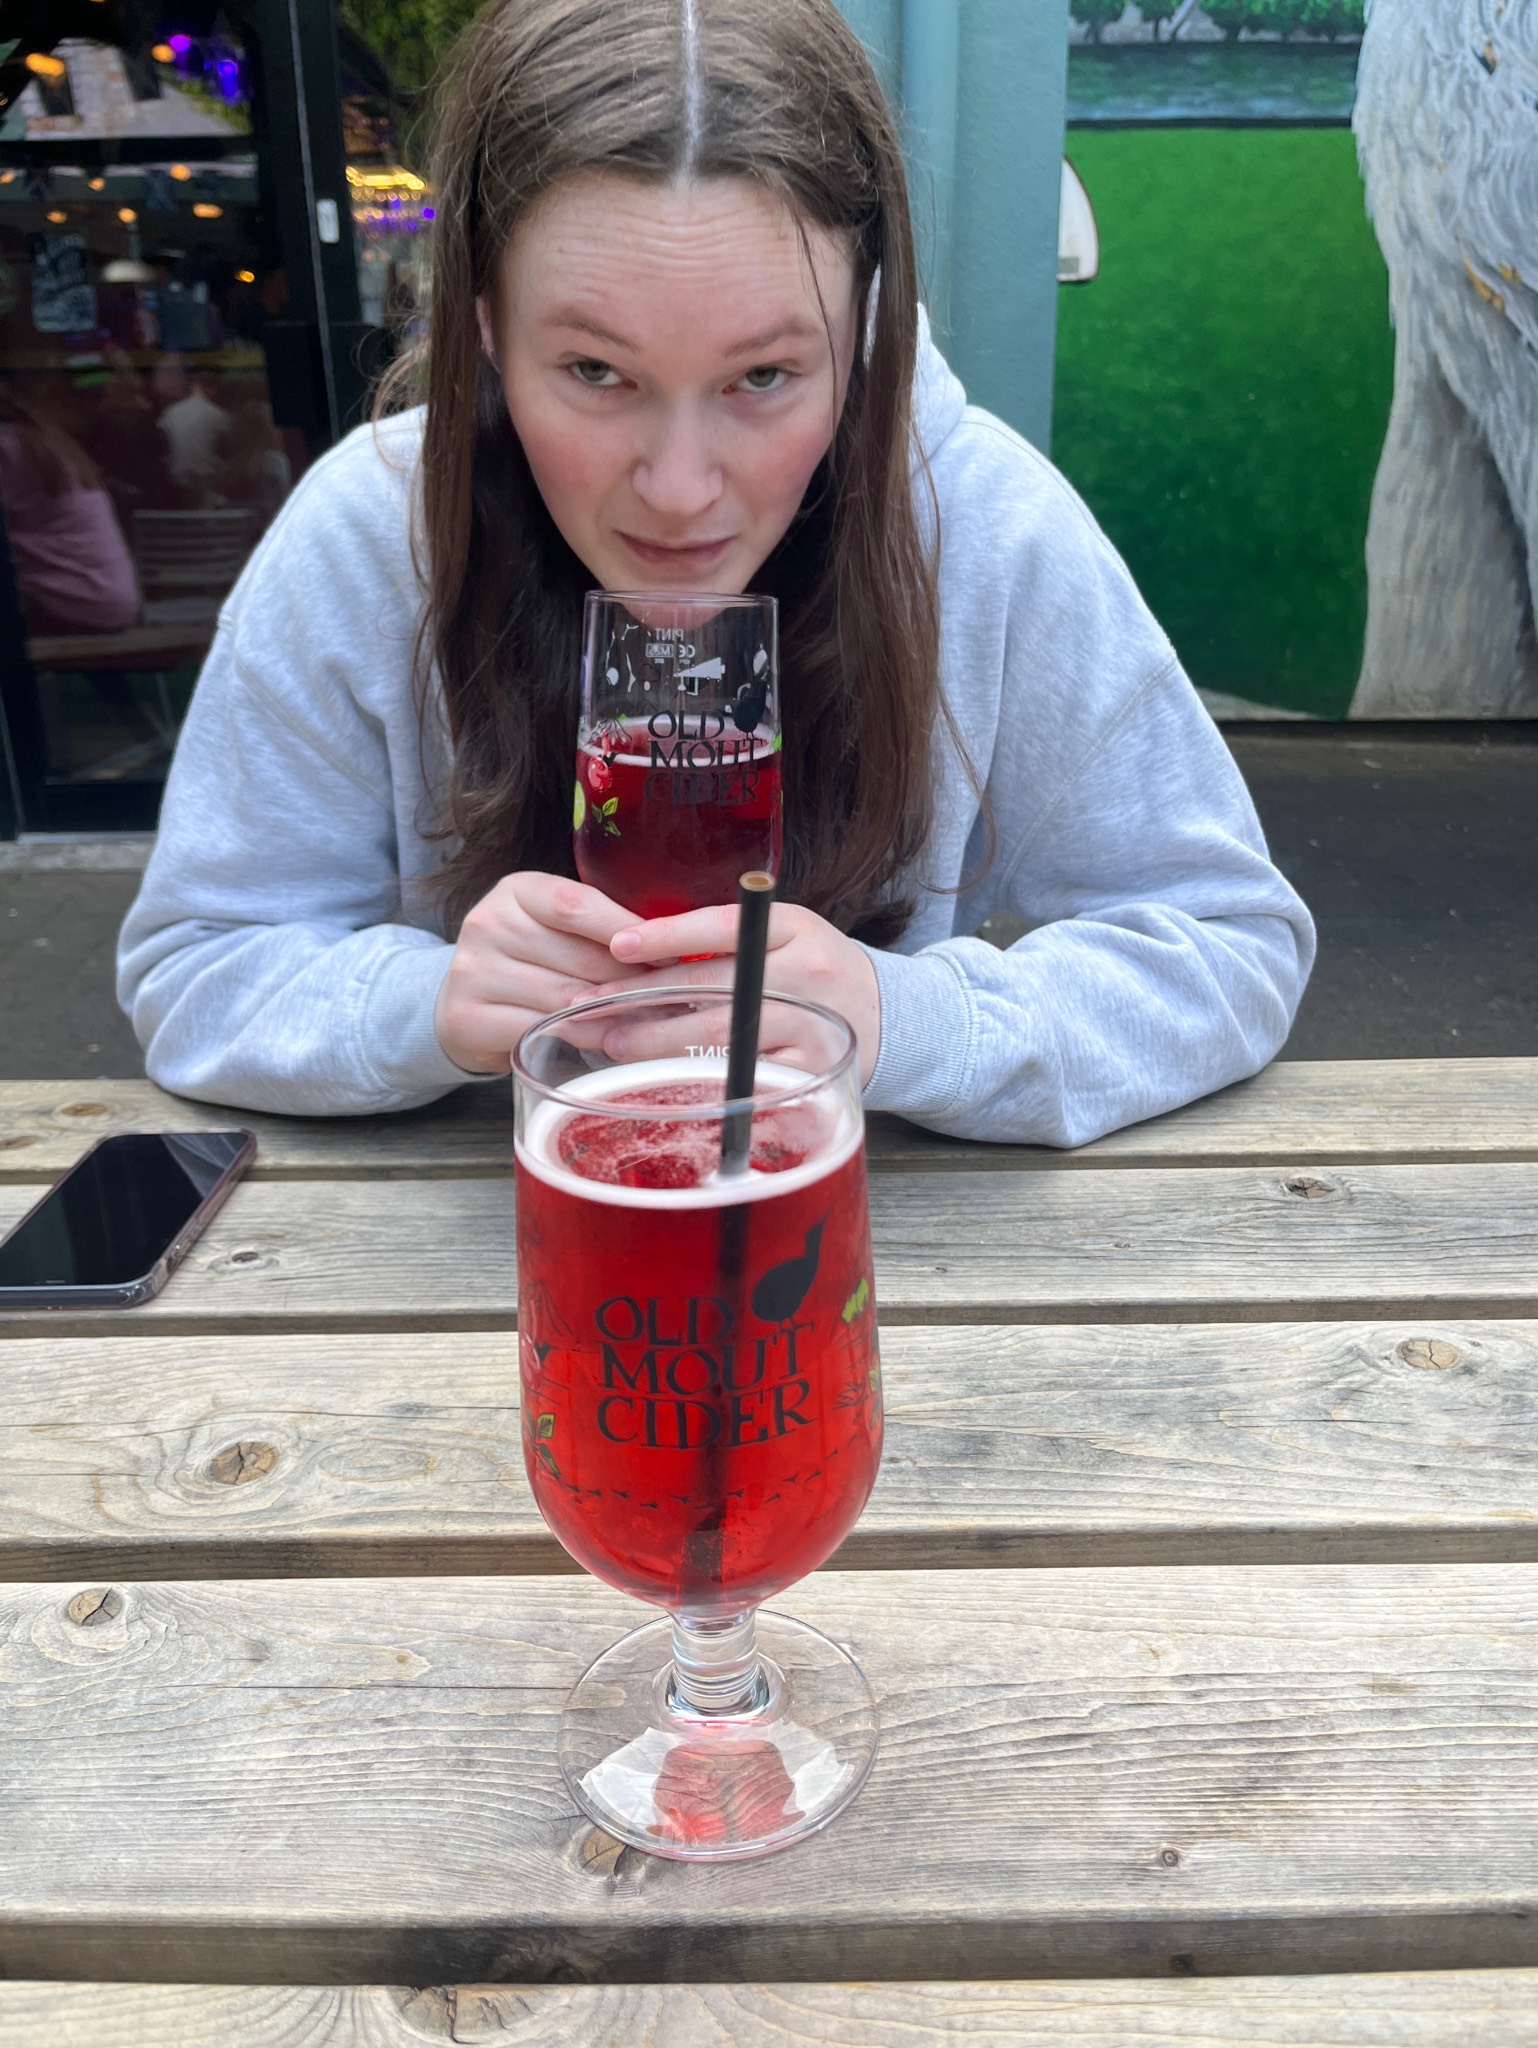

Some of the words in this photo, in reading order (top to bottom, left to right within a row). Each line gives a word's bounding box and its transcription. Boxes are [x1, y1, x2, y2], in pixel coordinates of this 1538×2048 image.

[647, 710, 725, 740] OLD
[647, 738, 764, 769] MOUT
[645, 771, 760, 805] CIDER
[594, 1296, 734, 1346] OLD
[601, 1322, 816, 1397] MOUT
[596, 1379, 818, 1450] CIDER
